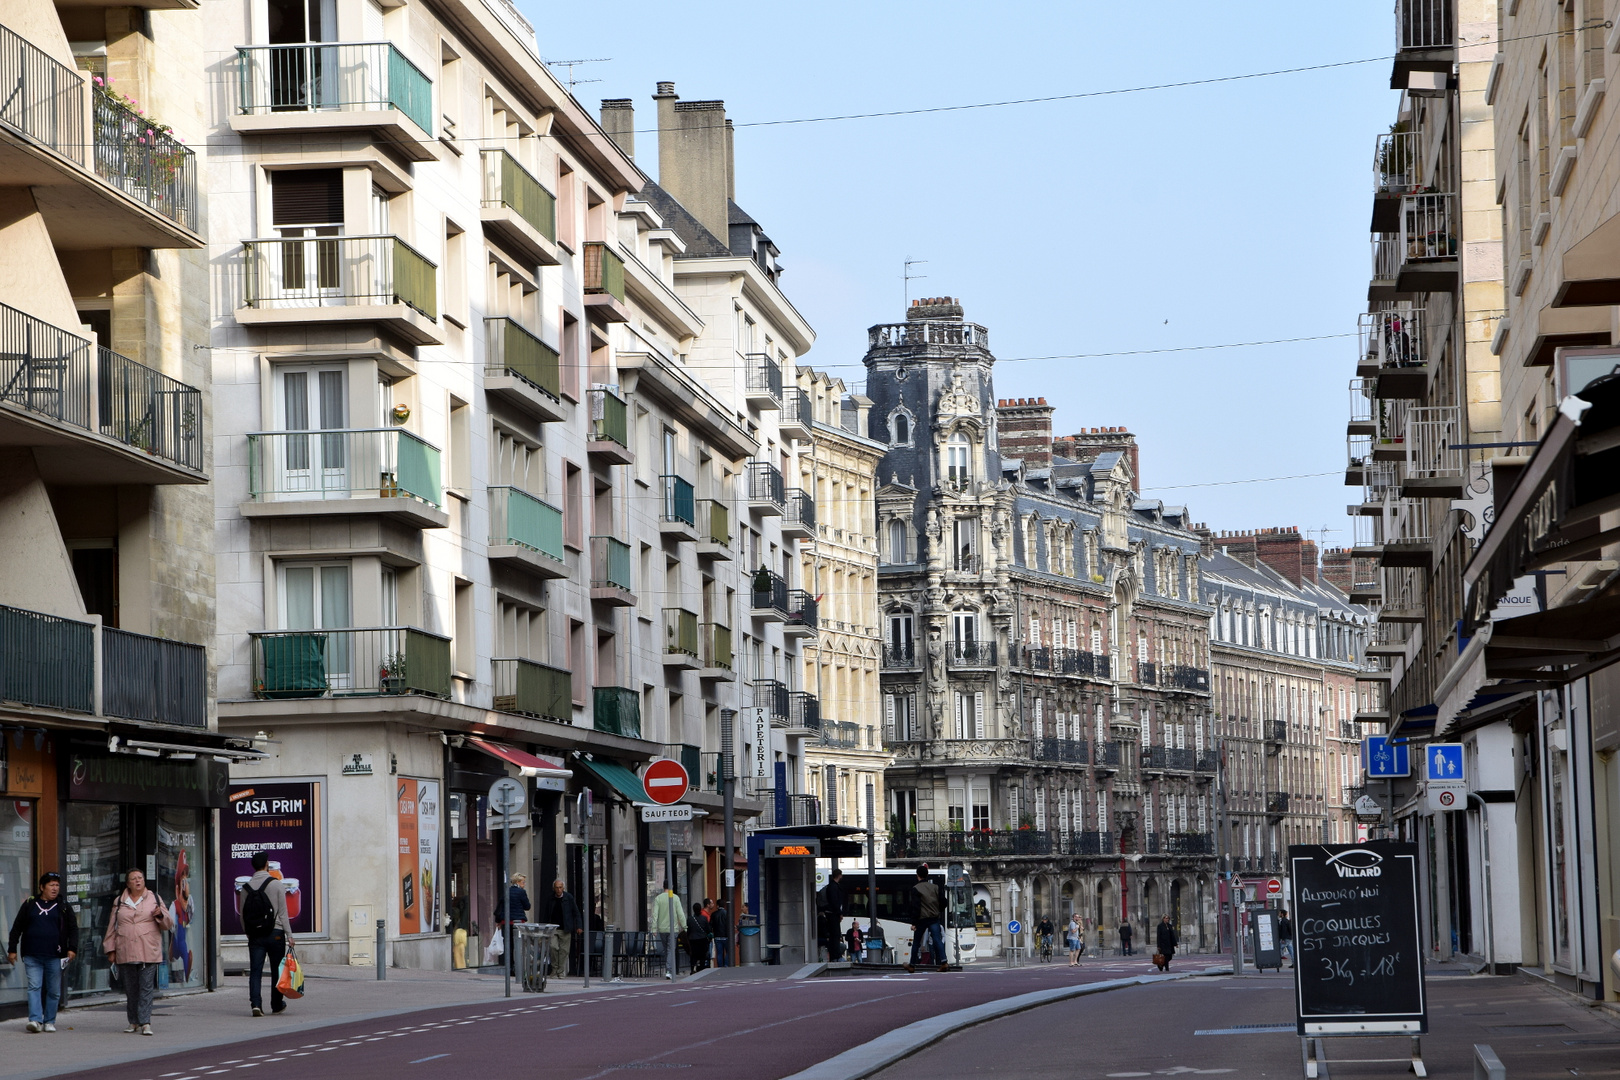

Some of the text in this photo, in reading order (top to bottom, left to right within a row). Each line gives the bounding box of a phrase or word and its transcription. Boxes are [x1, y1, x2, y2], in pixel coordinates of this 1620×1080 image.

[1498, 596, 1532, 604] ANQUE
[756, 708, 765, 777] PAPETERIE
[236, 800, 268, 814] CASA
[645, 809, 690, 818] SAUF TEOR
[231, 841, 293, 852] DÉCOUVREZ NOTRE RAYON
[1334, 863, 1382, 878] VILLARD
[1301, 915, 1381, 936] COQUILLES
[1303, 932, 1391, 951] ST JACQUES
